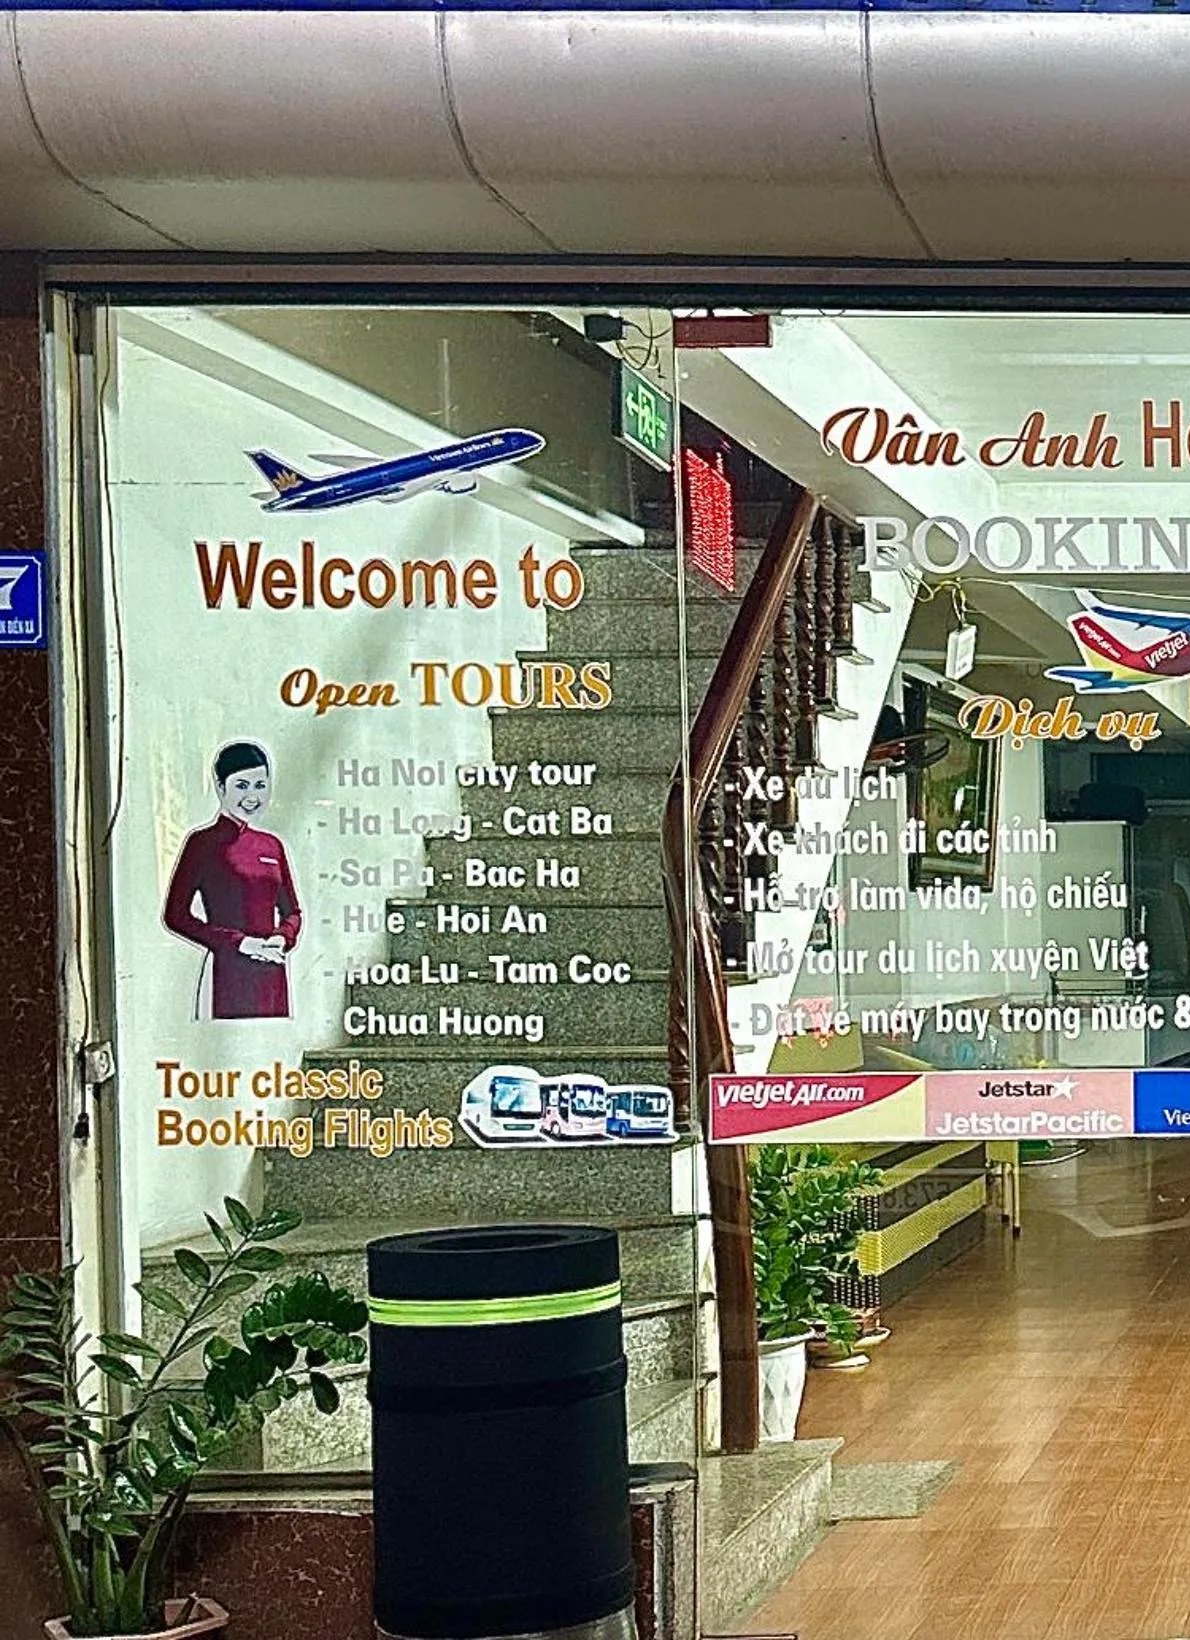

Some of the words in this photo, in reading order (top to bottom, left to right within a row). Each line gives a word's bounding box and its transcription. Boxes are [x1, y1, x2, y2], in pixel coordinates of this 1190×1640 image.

[822, 404, 966, 468] Vân
[979, 409, 1124, 469] Anh
[193, 540, 499, 610] Welcome
[518, 543, 584, 610] to
[280, 666, 400, 716] Open
[410, 661, 612, 710] TOURS
[958, 694, 1088, 750] Dịch
[1096, 710, 1162, 751] vụ
[337, 758, 381, 788] Ha
[457, 760, 518, 793] city
[527, 760, 598, 787] tour
[742, 766, 785, 801] Xe
[843, 765, 898, 807] lịch
[338, 807, 382, 836] Ha
[392, 807, 473, 842] Long
[502, 806, 561, 836] Cat
[570, 806, 613, 836] Ba
[742, 821, 785, 856] Xe
[795, 819, 889, 855] khách
[899, 817, 928, 855] đi
[935, 821, 991, 856] các
[998, 812, 1058, 856] tỉnh
[339, 858, 382, 888] Sa
[392, 858, 435, 888] Pa
[465, 858, 526, 889] Bac
[536, 858, 581, 889] Ha
[850, 876, 907, 912] làm
[1000, 875, 1038, 917] hộ
[1047, 870, 1129, 910] chiếu
[343, 904, 406, 934] Hue
[436, 904, 491, 935] Hoi
[501, 904, 548, 935] An
[346, 956, 411, 986] Hoa
[420, 955, 460, 985] Lu
[488, 955, 558, 985] Tam
[568, 955, 632, 985] Coc
[804, 945, 869, 975] tour
[878, 939, 916, 975] du
[925, 939, 981, 980] lịch
[990, 938, 1080, 980] xuyên
[1088, 936, 1150, 979] Việt
[343, 1006, 429, 1037] Chua
[439, 1006, 545, 1043] Huong
[861, 1001, 927, 1042] máy
[935, 1000, 990, 1041] bay
[999, 1002, 1082, 1039] trong
[1091, 994, 1165, 1033] nước
[155, 1060, 242, 1099] Tour
[251, 1060, 384, 1100] classic
[978, 1080, 1055, 1098] Jetstar
[156, 1109, 314, 1158] Booking
[324, 1108, 454, 1158] Flights
[935, 1110, 1125, 1135] JetstarPacific
